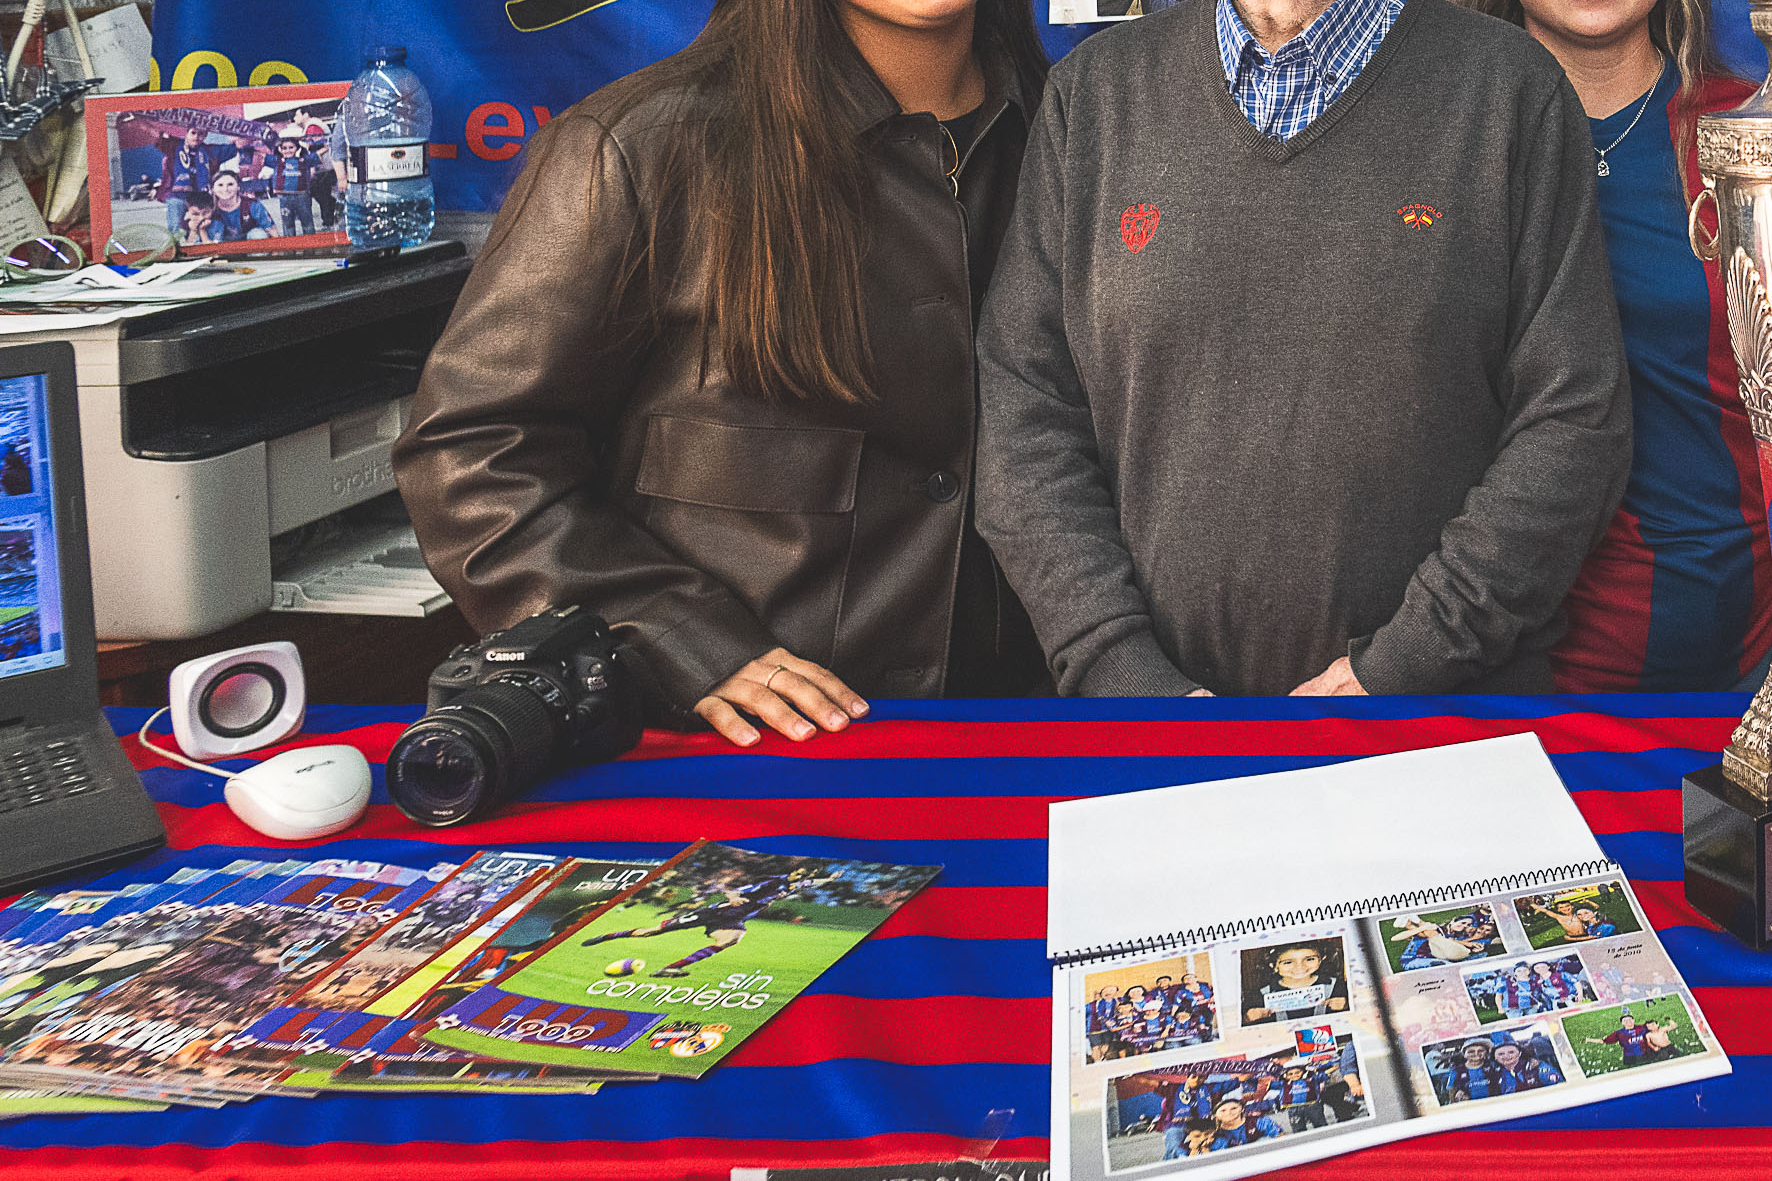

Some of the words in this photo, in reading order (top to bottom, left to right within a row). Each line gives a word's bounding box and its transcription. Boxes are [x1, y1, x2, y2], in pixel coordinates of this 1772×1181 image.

[1397, 203, 1443, 219] SPAGNOLO
[485, 650, 526, 662] Canon
[718, 969, 774, 991] sin
[586, 978, 771, 1011] complejos
